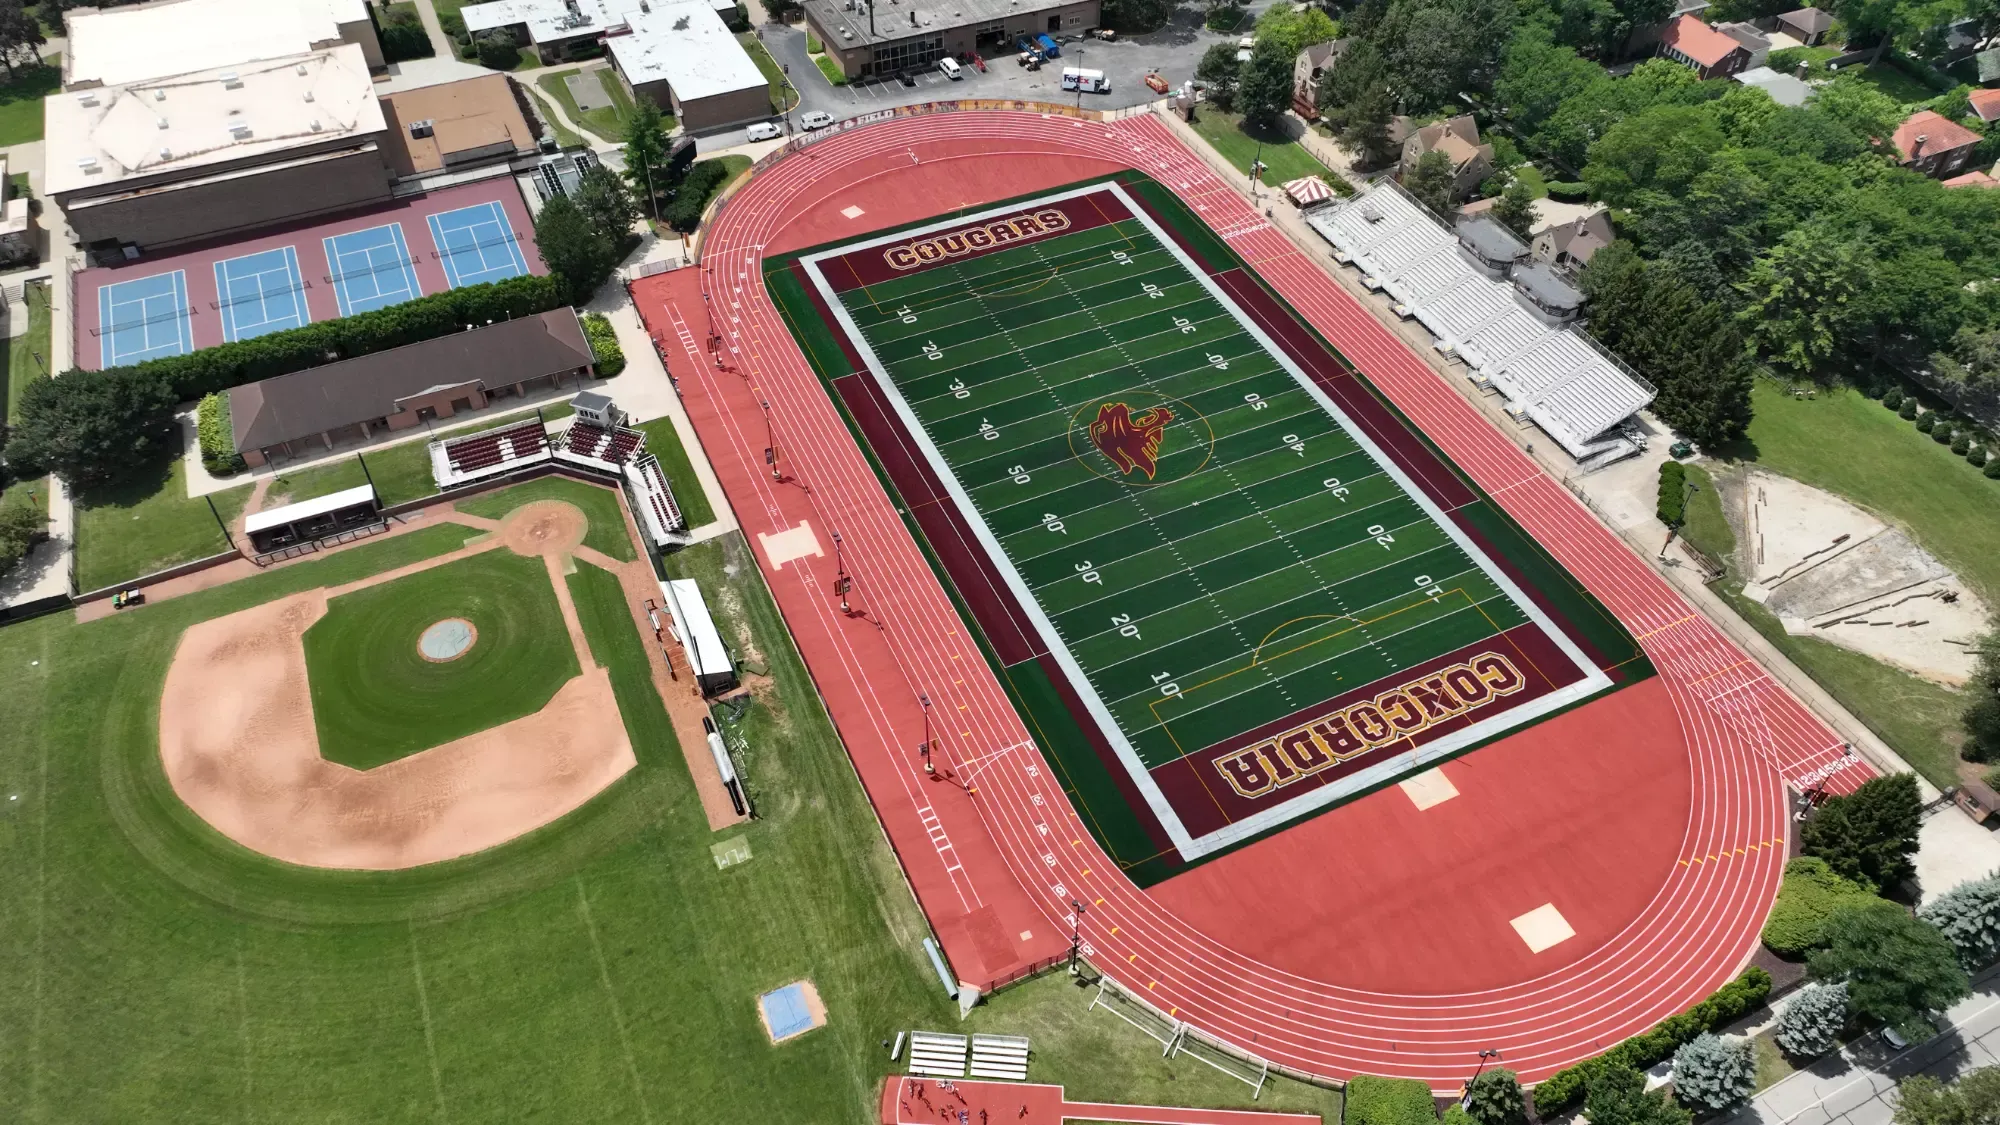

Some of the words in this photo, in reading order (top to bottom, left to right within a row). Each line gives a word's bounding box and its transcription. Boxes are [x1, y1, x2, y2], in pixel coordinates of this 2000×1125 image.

[1064, 75, 1089, 84] FedEx
[800, 123, 840, 145] TRACK
[857, 110, 894, 125] FIELD
[883, 209, 1071, 270] COUGARS
[1112, 250, 1132, 265] 10
[1143, 282, 1164, 299] 20
[897, 307, 917, 324] 10
[1174, 318, 1196, 334] 30
[922, 344, 943, 360] 20
[1208, 354, 1230, 370] 40
[949, 382, 971, 399] 30
[1244, 393, 1267, 411] 50
[978, 423, 1000, 440] 40
[1282, 434, 1304, 452] 40
[1008, 464, 1031, 484] 50
[1323, 477, 1349, 498] 30
[1041, 512, 1064, 533] 40
[1366, 524, 1394, 545] 20
[1074, 560, 1099, 583] 30
[1414, 574, 1443, 598] 10
[1110, 612, 1138, 638] 20
[1151, 671, 1179, 697] 10
[1212, 651, 1526, 799] CONCORDIA
